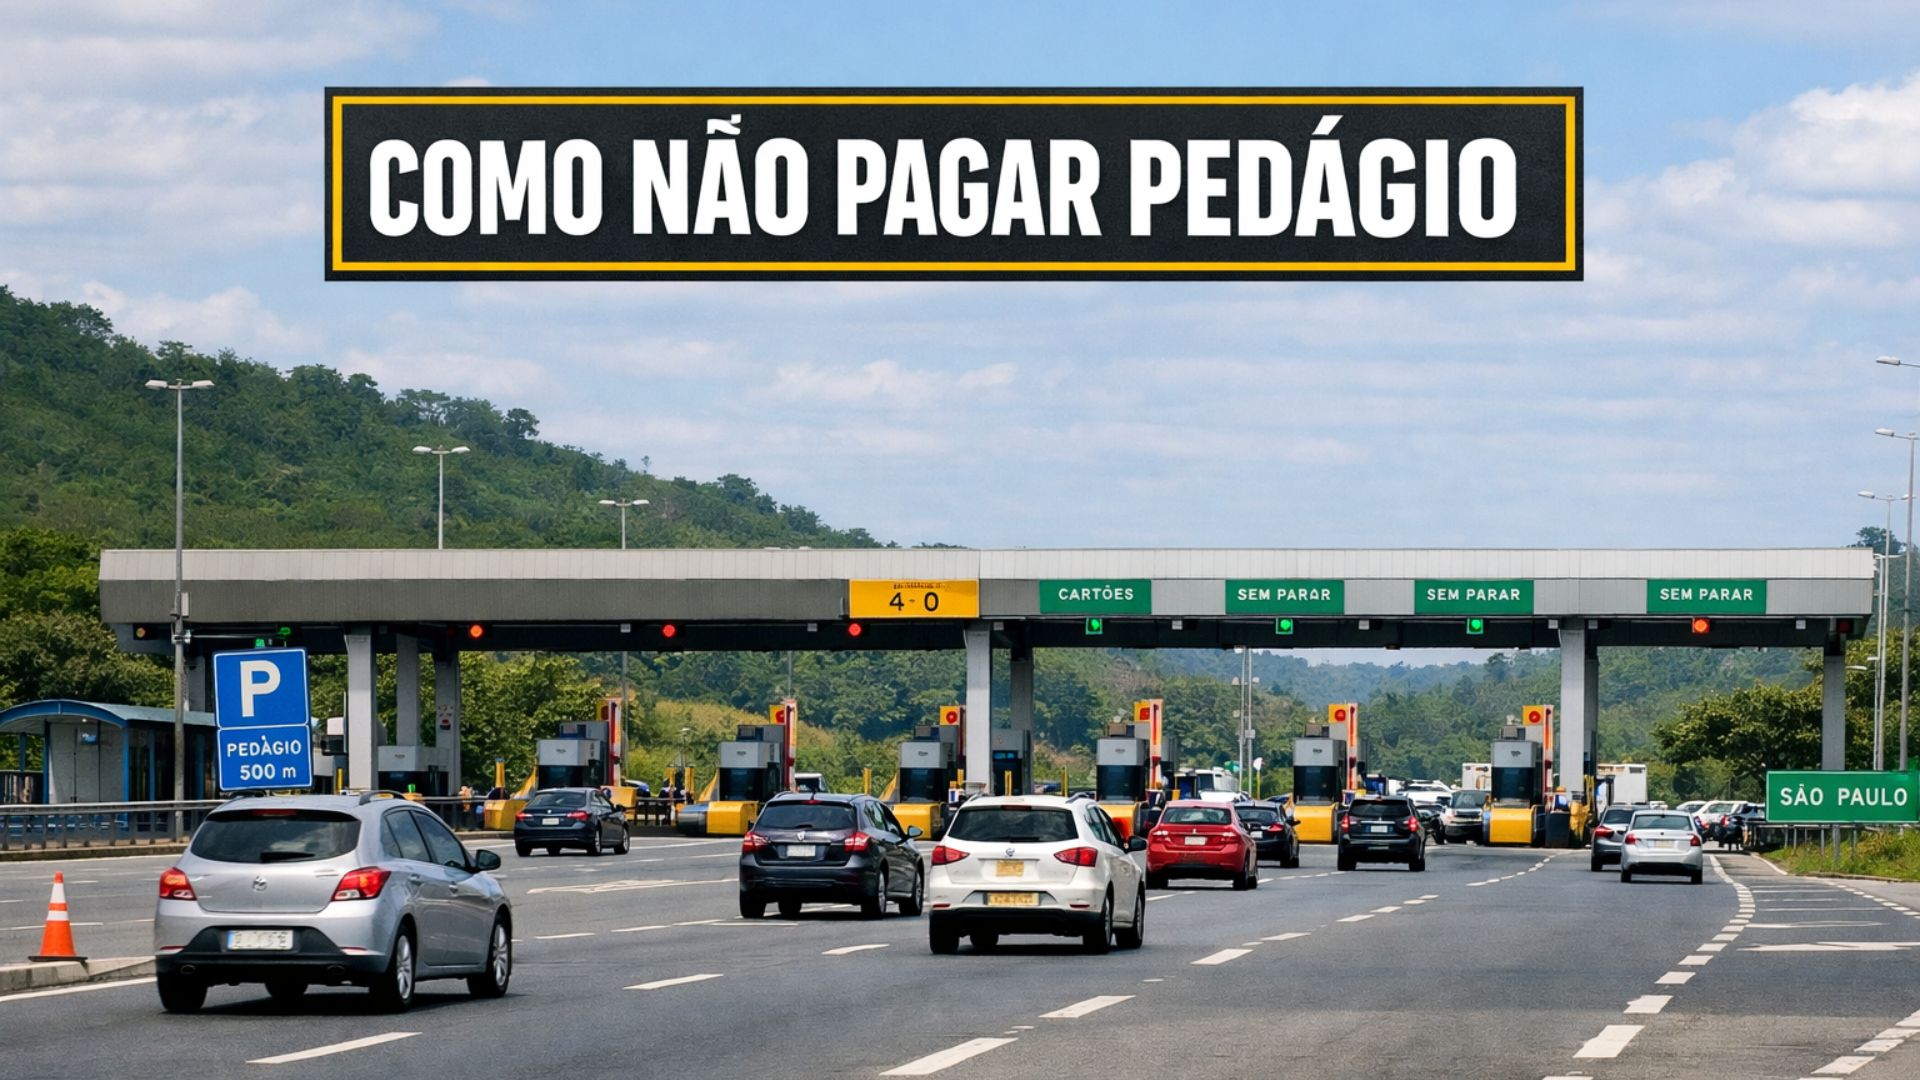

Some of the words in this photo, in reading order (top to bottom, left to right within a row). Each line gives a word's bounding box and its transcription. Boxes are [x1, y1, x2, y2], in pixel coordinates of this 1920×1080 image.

[889, 592, 905, 611] 4
[1058, 585, 1134, 601] CARTÕES
[1237, 588, 1271, 601] SEM
[1277, 588, 1331, 601] PARAR
[1426, 588, 1460, 601] SEM
[1466, 588, 1520, 601] PARAR
[1659, 588, 1693, 601] SEM
[1699, 588, 1753, 601] PARAR
[239, 660, 281, 717] P
[240, 763, 276, 781] 500
[282, 766, 297, 779] m
[1779, 783, 1824, 806] SÃO
[1837, 787, 1908, 806] PAULO
